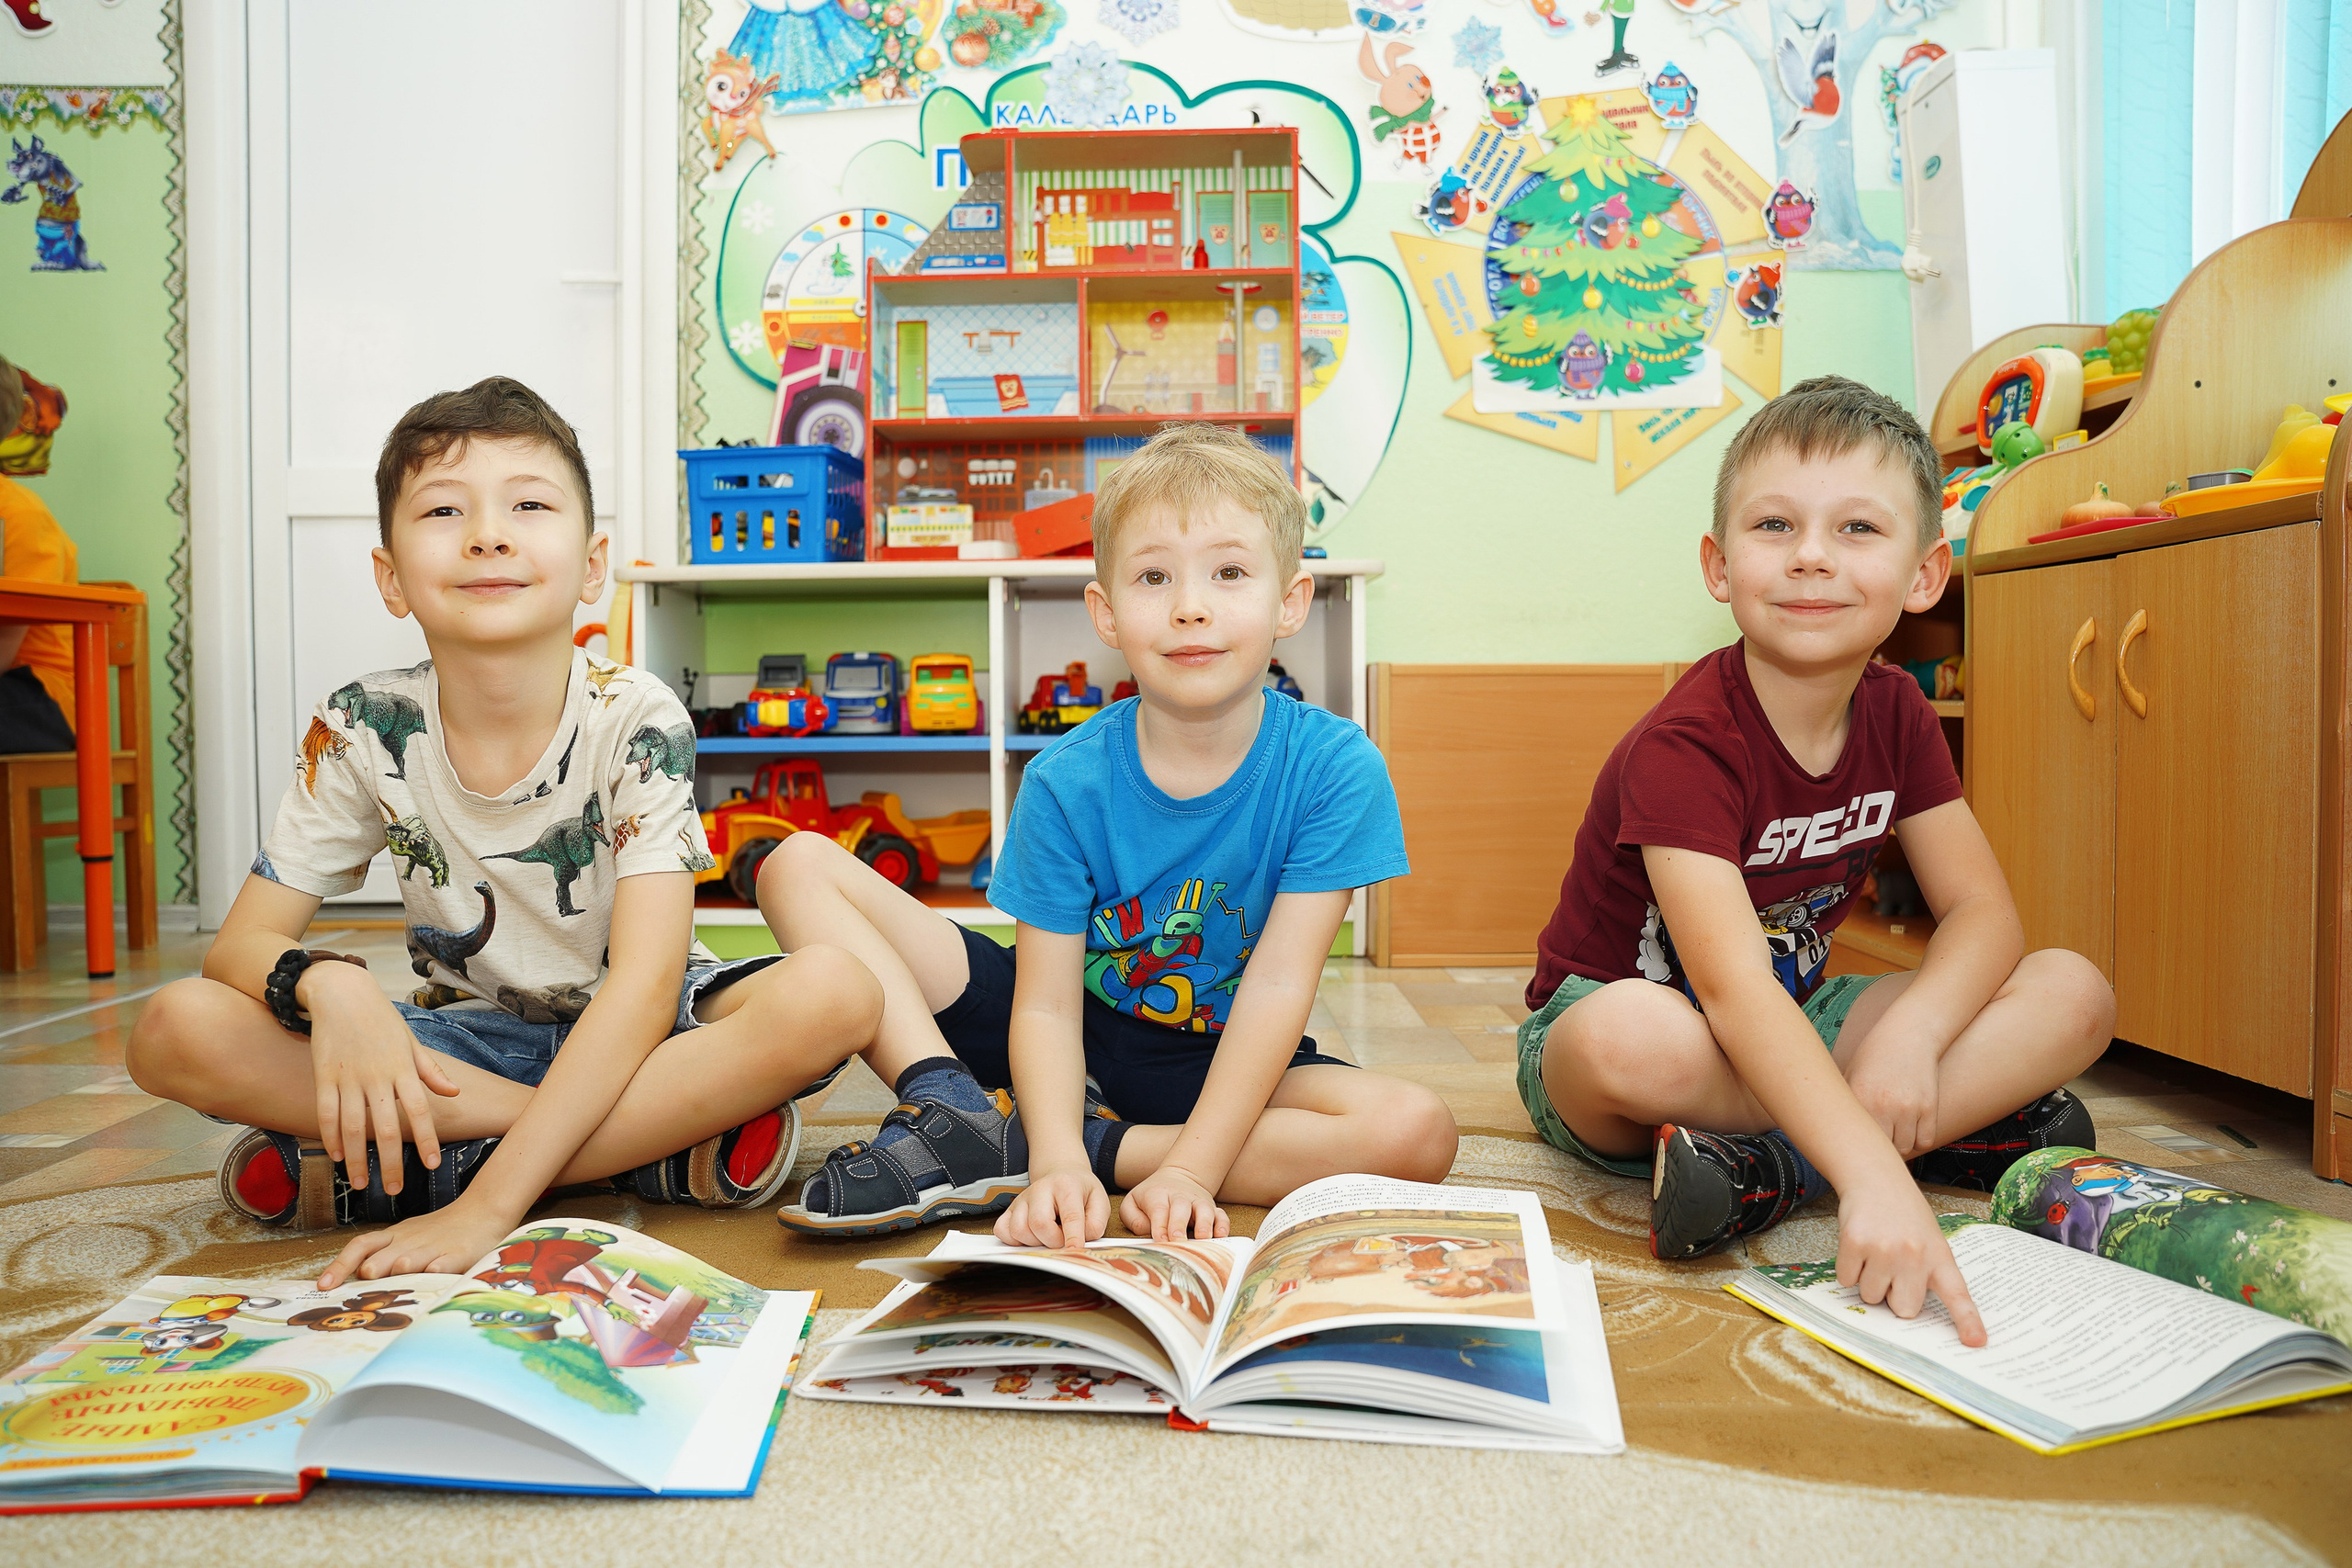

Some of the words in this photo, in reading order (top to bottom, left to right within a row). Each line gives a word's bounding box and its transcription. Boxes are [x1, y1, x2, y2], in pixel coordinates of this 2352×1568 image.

[996, 104, 1177, 126] КАЛАРЬ
[1479, 131, 1504, 169] рождень
[1301, 328, 1343, 337] ТРЕННО
[49, 1377, 304, 1406] МУЛЬТФИЛЬМЫ
[49, 1395, 269, 1421] ЛЮБИМЫЕ
[50, 1414, 228, 1437] САМЫЕ
